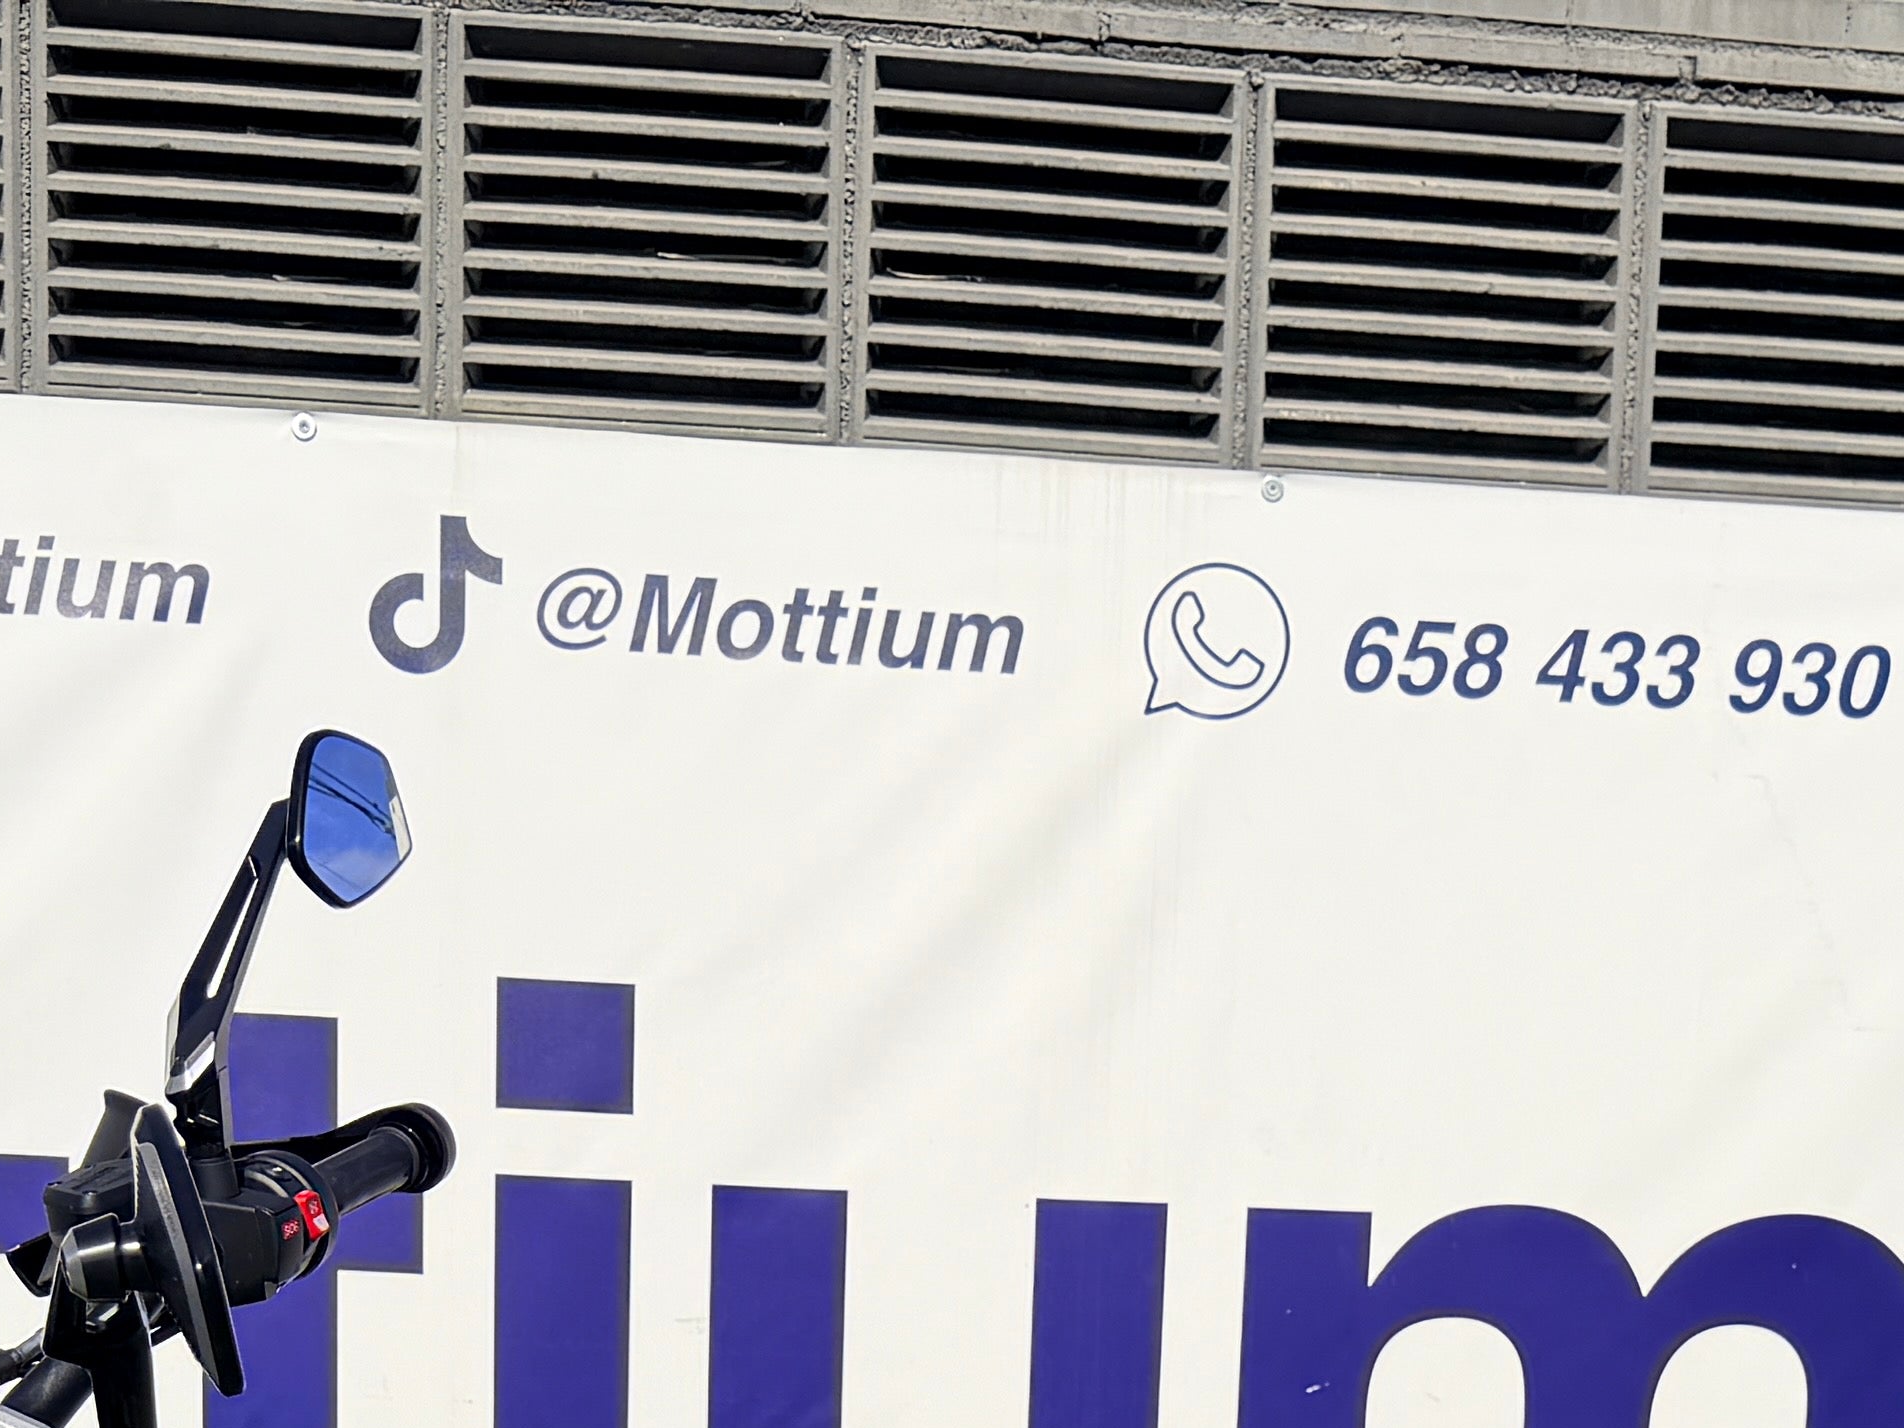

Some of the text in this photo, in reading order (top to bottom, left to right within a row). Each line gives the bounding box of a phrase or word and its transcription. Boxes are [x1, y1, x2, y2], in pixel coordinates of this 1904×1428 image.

[536, 566, 1025, 675] @Mottium
[1342, 616, 1892, 720] 658 433 930
